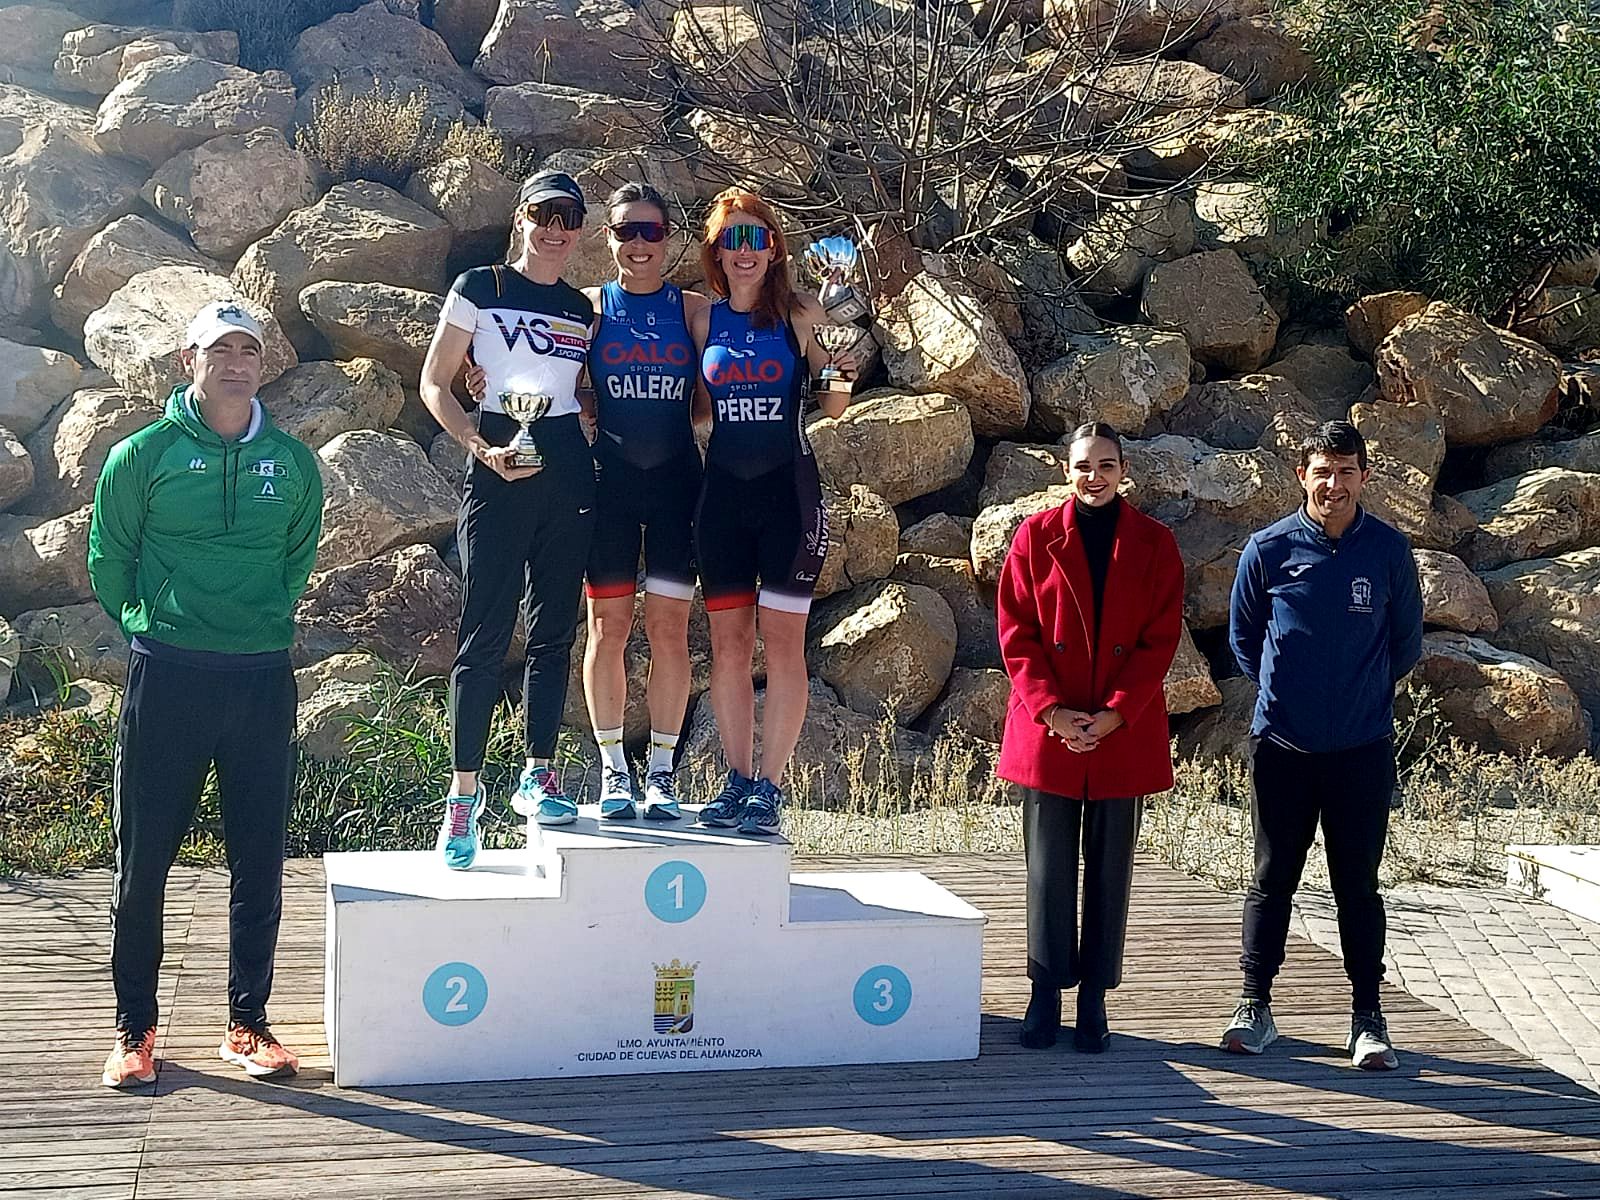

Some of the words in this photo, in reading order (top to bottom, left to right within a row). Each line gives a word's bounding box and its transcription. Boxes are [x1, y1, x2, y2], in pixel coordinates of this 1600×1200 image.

[558, 348, 581, 359] SPORT
[602, 341, 690, 365] GALO
[630, 365, 664, 373] SPORT
[706, 359, 784, 386] GALO
[606, 374, 686, 401] GALERA
[731, 383, 758, 392] SPORT
[717, 393, 784, 422] PÉREZ
[666, 874, 684, 910] 1
[445, 976, 468, 1013] 2
[873, 978, 894, 1013] 3
[577, 1052, 617, 1062] CIUDAD
[619, 1051, 634, 1060] DE
[636, 1050, 677, 1060] CUEVAS
[679, 1049, 699, 1059] DEL
[700, 1048, 763, 1059] ALMANZORA
